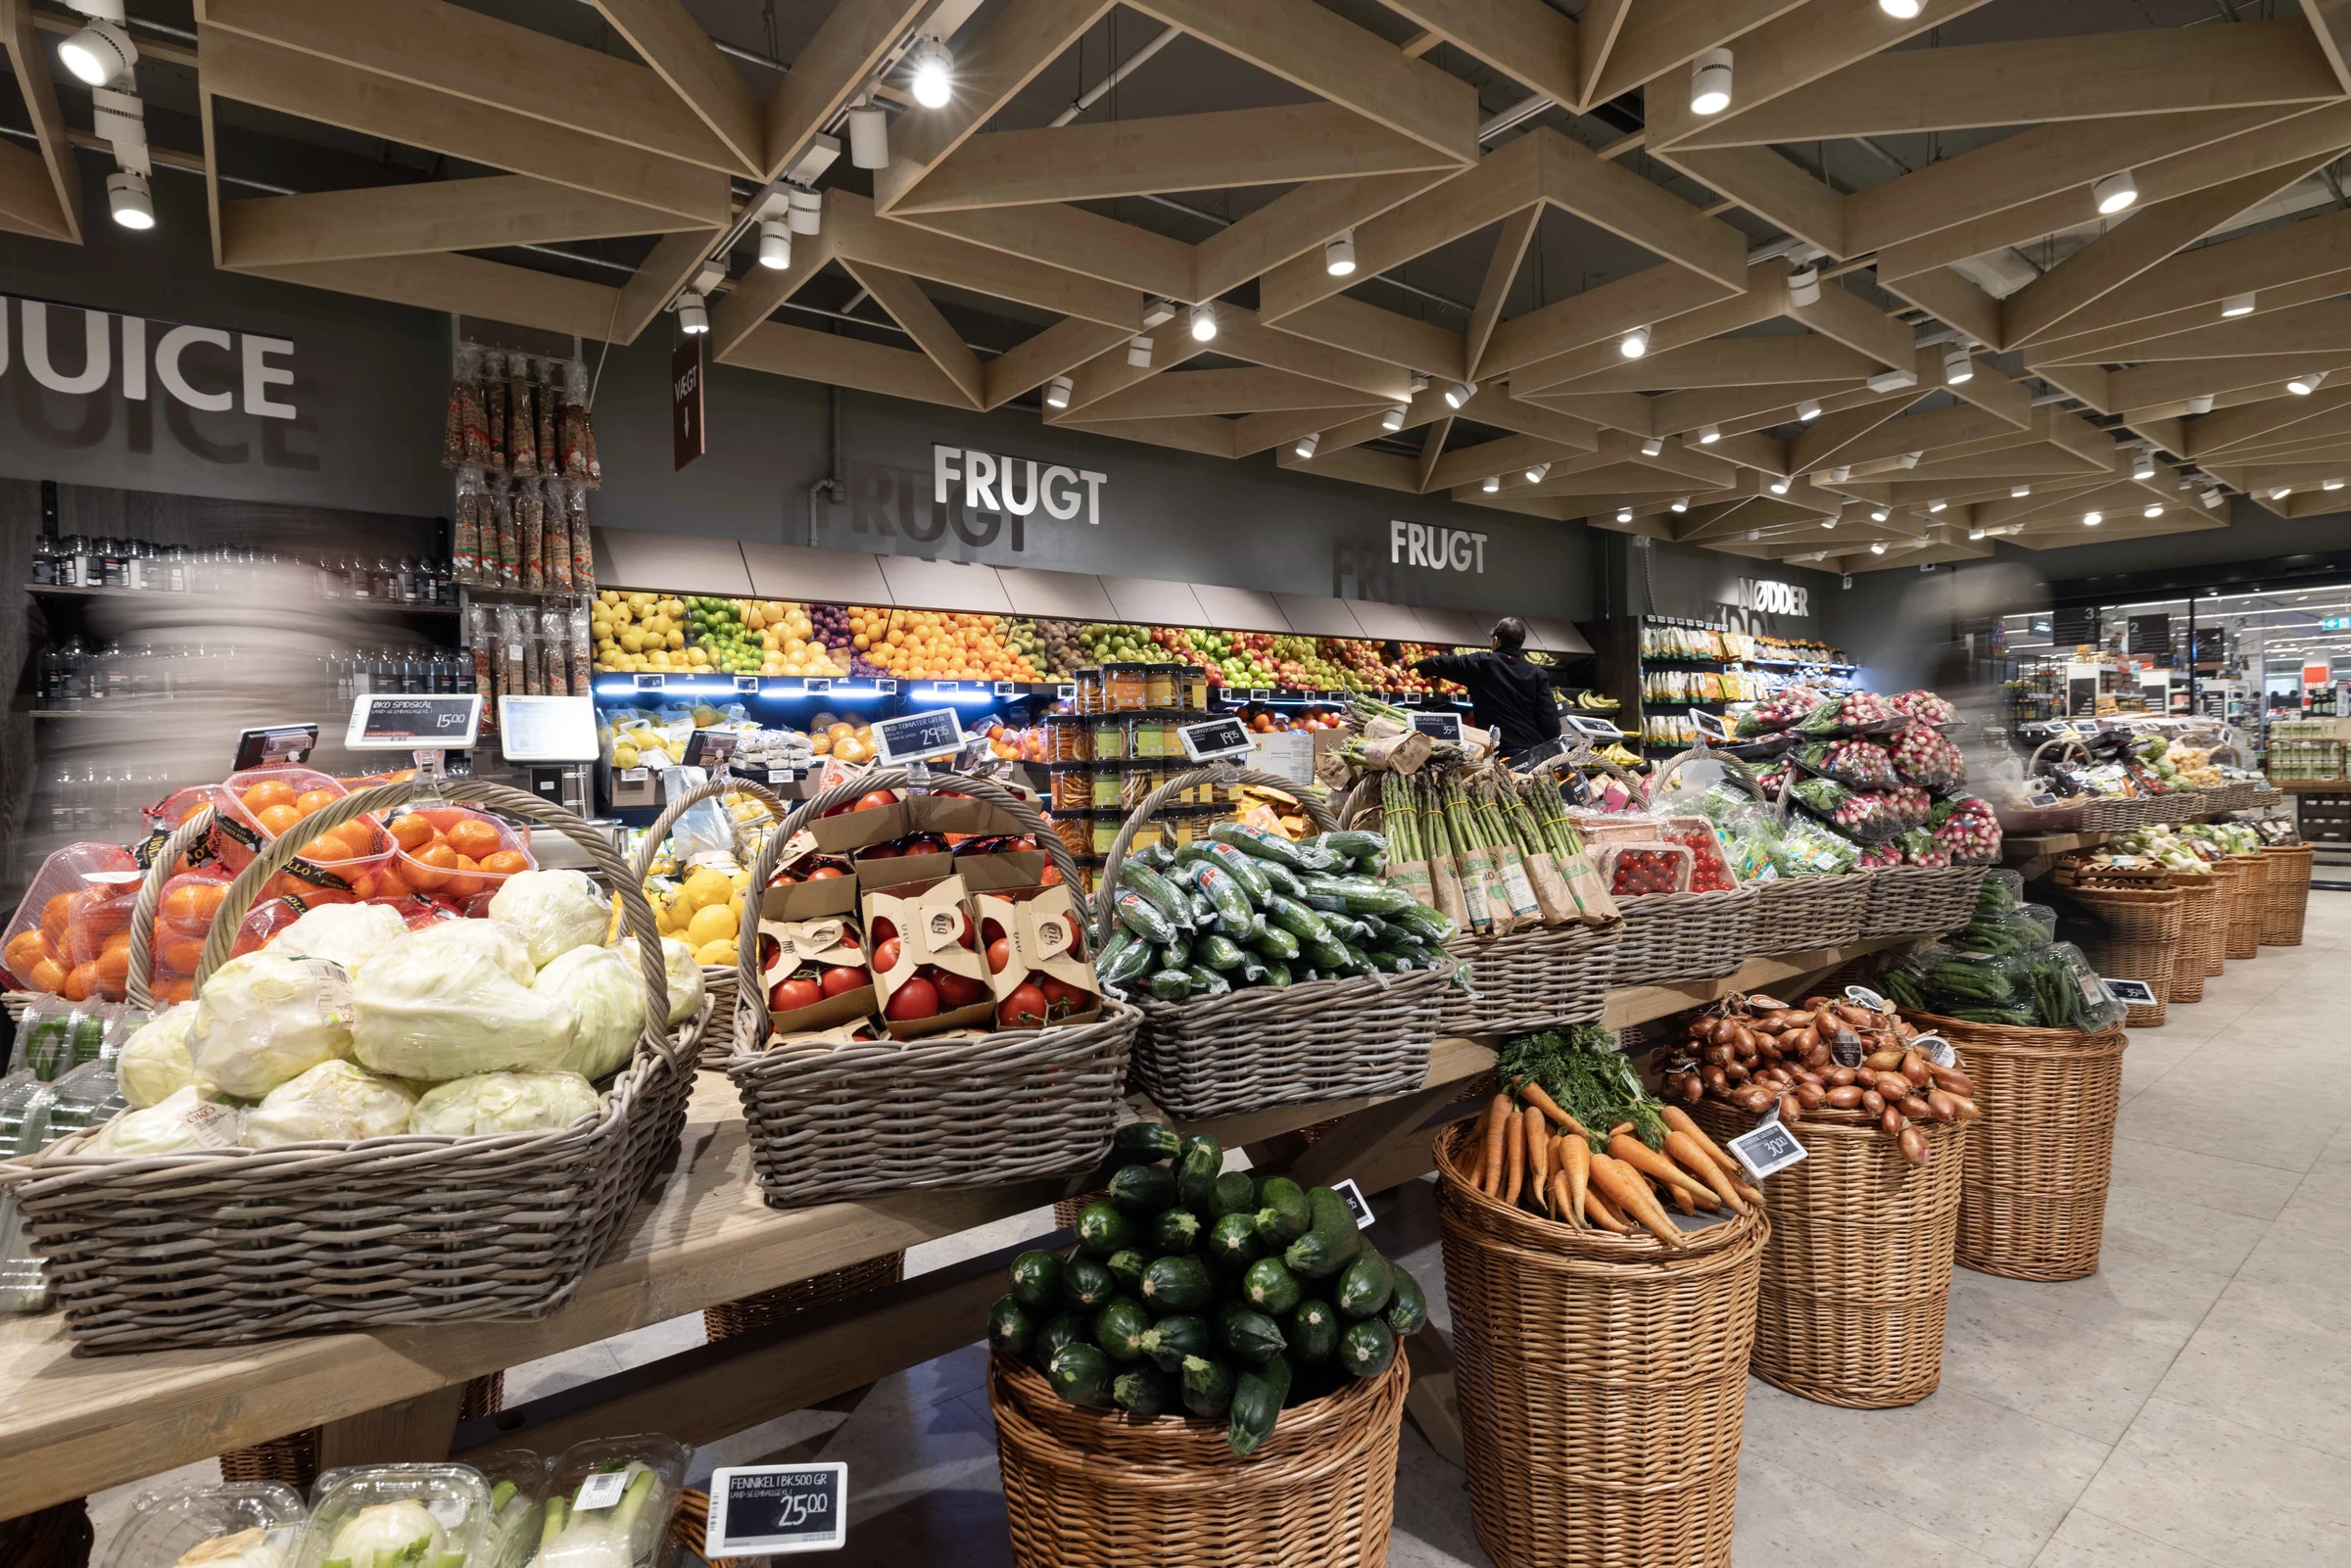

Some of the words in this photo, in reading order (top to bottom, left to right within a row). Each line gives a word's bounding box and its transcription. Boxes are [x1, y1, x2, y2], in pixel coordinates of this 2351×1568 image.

[0, 296, 296, 419] UICE
[675, 364, 696, 403] VÆGT
[934, 445, 1108, 525] FRUGT
[1391, 520, 1487, 573] FRUGT
[1739, 577, 1809, 617] NØDDER
[2085, 607, 2094, 619] 3
[2130, 622, 2139, 633] 2
[372, 700, 391, 709] ØKO
[392, 700, 433, 709] SPIDSKÅL
[286, 860, 311, 876] LLO
[282, 894, 305, 915] BOLL
[731, 1476, 775, 1490] FENNIKEL
[814, 1473, 828, 1486] GR
